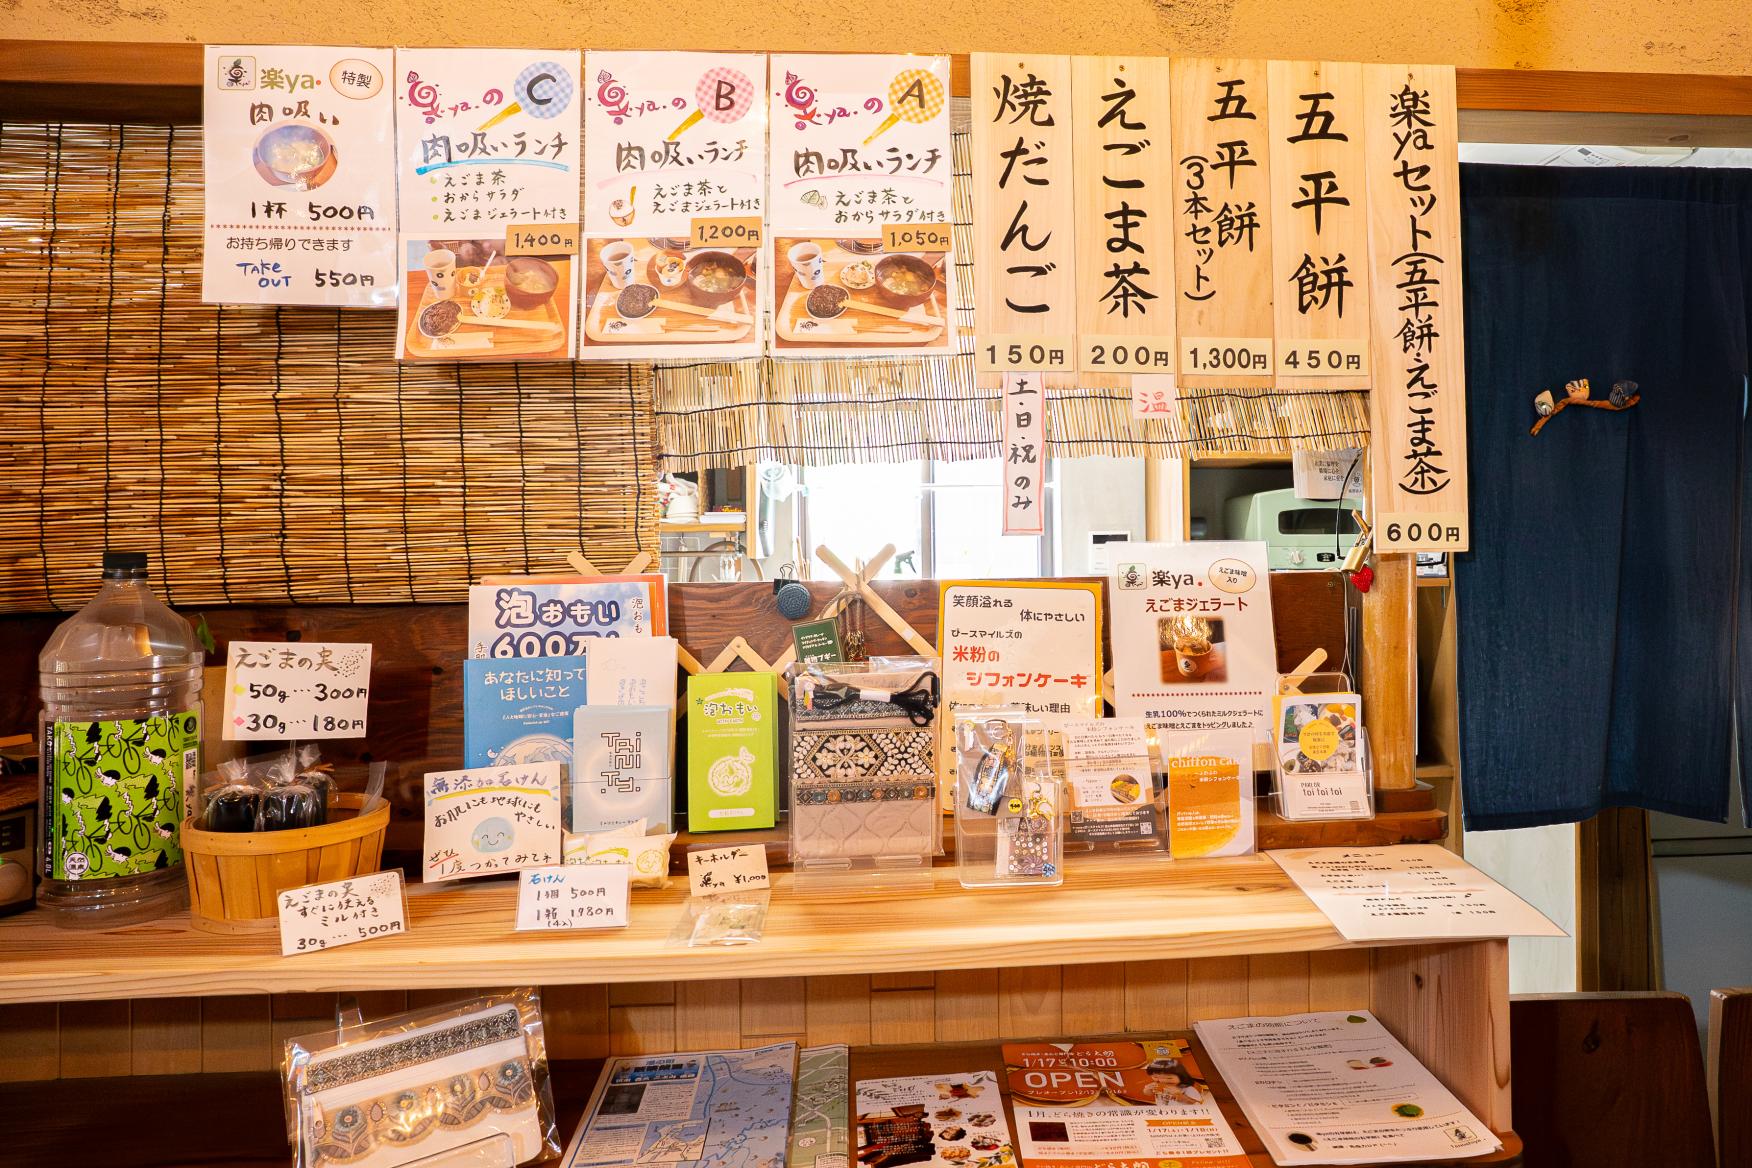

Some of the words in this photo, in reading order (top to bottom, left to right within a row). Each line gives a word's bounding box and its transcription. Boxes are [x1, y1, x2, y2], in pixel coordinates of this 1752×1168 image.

[341, 71, 373, 90] 特製
[527, 73, 557, 106] C
[715, 79, 736, 112] B
[897, 79, 925, 109] A
[250, 100, 340, 126] 肉吸い
[420, 131, 569, 164] 肉吸いランチ
[615, 140, 750, 173] 肉吸いランチ
[793, 148, 943, 178] 肉吸いランチ
[1207, 79, 1261, 252] 五平餅
[443, 171, 508, 187] えごま茶
[443, 188, 525, 204] おからサラダ
[653, 181, 728, 198] えごま茶と
[835, 189, 914, 206] えごま茶と
[992, 73, 1057, 314] 焼だんご
[1097, 77, 1159, 319] えごま茶
[250, 201, 288, 219] 1杯
[308, 202, 375, 221] 500円
[443, 207, 568, 222] えごまジェラート付き
[652, 198, 761, 214] えごまジェラート付き
[1286, 91, 1354, 319] 五平餅
[834, 209, 946, 225] おからサラダ付き
[698, 225, 760, 243] 1,200円
[1179, 155, 1217, 301] (3本セット)
[226, 236, 354, 253] お持ち帰りできます
[514, 233, 573, 249] 1,400円
[890, 231, 950, 249] 1,050円
[314, 269, 375, 288] 550円
[986, 345, 1064, 365] 150円
[1091, 345, 1169, 367] 200円
[1189, 347, 1267, 370] 1,300円
[1284, 349, 1361, 371] 450円
[1138, 391, 1171, 414] 温
[1386, 522, 1460, 543] 600円
[1219, 567, 1248, 577] えごま味噌
[496, 589, 620, 627] 泡おもい
[953, 594, 1013, 608] 笑顔溢れる
[1145, 596, 1248, 613] えごまジェラート
[1020, 609, 1085, 622] 体にやさしい
[235, 647, 338, 672] えごまの実
[953, 645, 1000, 663] 米粉の
[484, 668, 585, 686] あなたに知って
[967, 671, 1087, 688] シフォンケーキ
[500, 686, 570, 701] ほしいこと
[704, 702, 757, 716] 泡おもい
[1172, 758, 1217, 768] chiffon
[430, 771, 547, 794] 無添加石けん
[435, 796, 541, 827] お肌にも地球にも
[514, 811, 555, 830] やさしい
[429, 849, 455, 862] ぜひ
[694, 850, 749, 865] キーホルダー
[528, 874, 566, 885] 石けん
[285, 882, 359, 909] えごまの実
[537, 890, 560, 900] 1個
[570, 888, 607, 899] 500円
[298, 896, 375, 918] すぐに使える
[536, 908, 558, 920] 1箱
[570, 908, 614, 918] 1980円
[321, 907, 379, 927] ミル付き
[1024, 1071, 1125, 1089] OPEN
